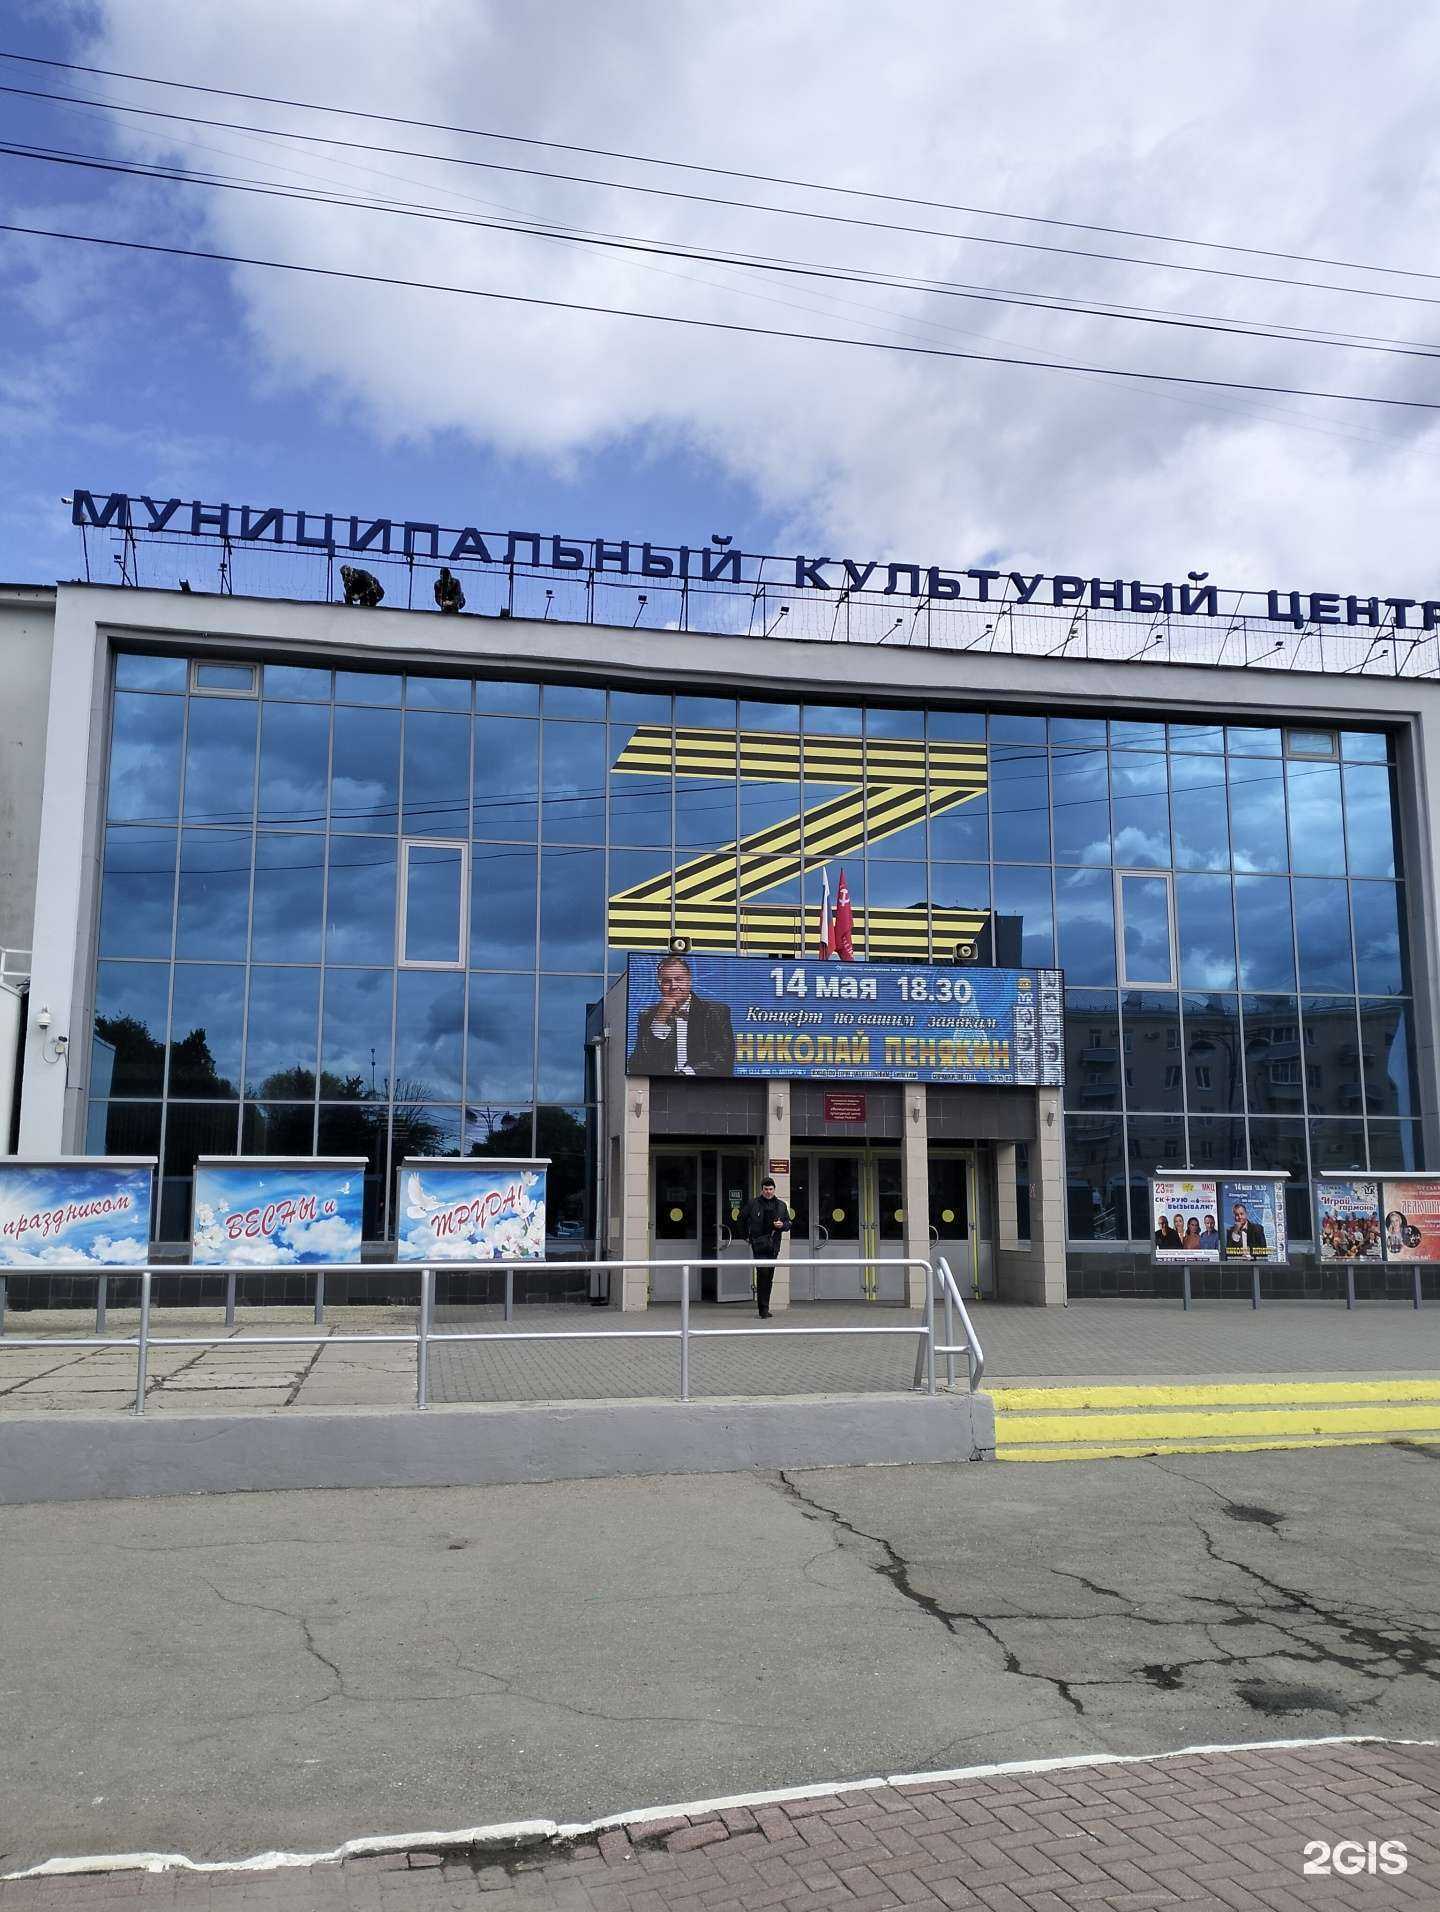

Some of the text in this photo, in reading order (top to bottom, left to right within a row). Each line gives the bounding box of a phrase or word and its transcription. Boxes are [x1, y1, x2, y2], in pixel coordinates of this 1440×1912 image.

[72, 489, 742, 584] МУНИЦИПАЛЬНЫЙ
[796, 556, 1217, 617] КУЛЬТУРНЫЙ
[770, 967, 973, 1004] 14 мая 18.30
[745, 1006, 997, 1029] Концерт по вашим заявкам
[735, 1029, 1010, 1070] НИКОЛАЙ ПЕНЯКИН
[1156, 1184, 1165, 1193] 23
[3, 1197, 129, 1241] праздником
[225, 1196, 336, 1240] ВЕСНЫ и
[431, 1184, 523, 1237] ТРУДА!
